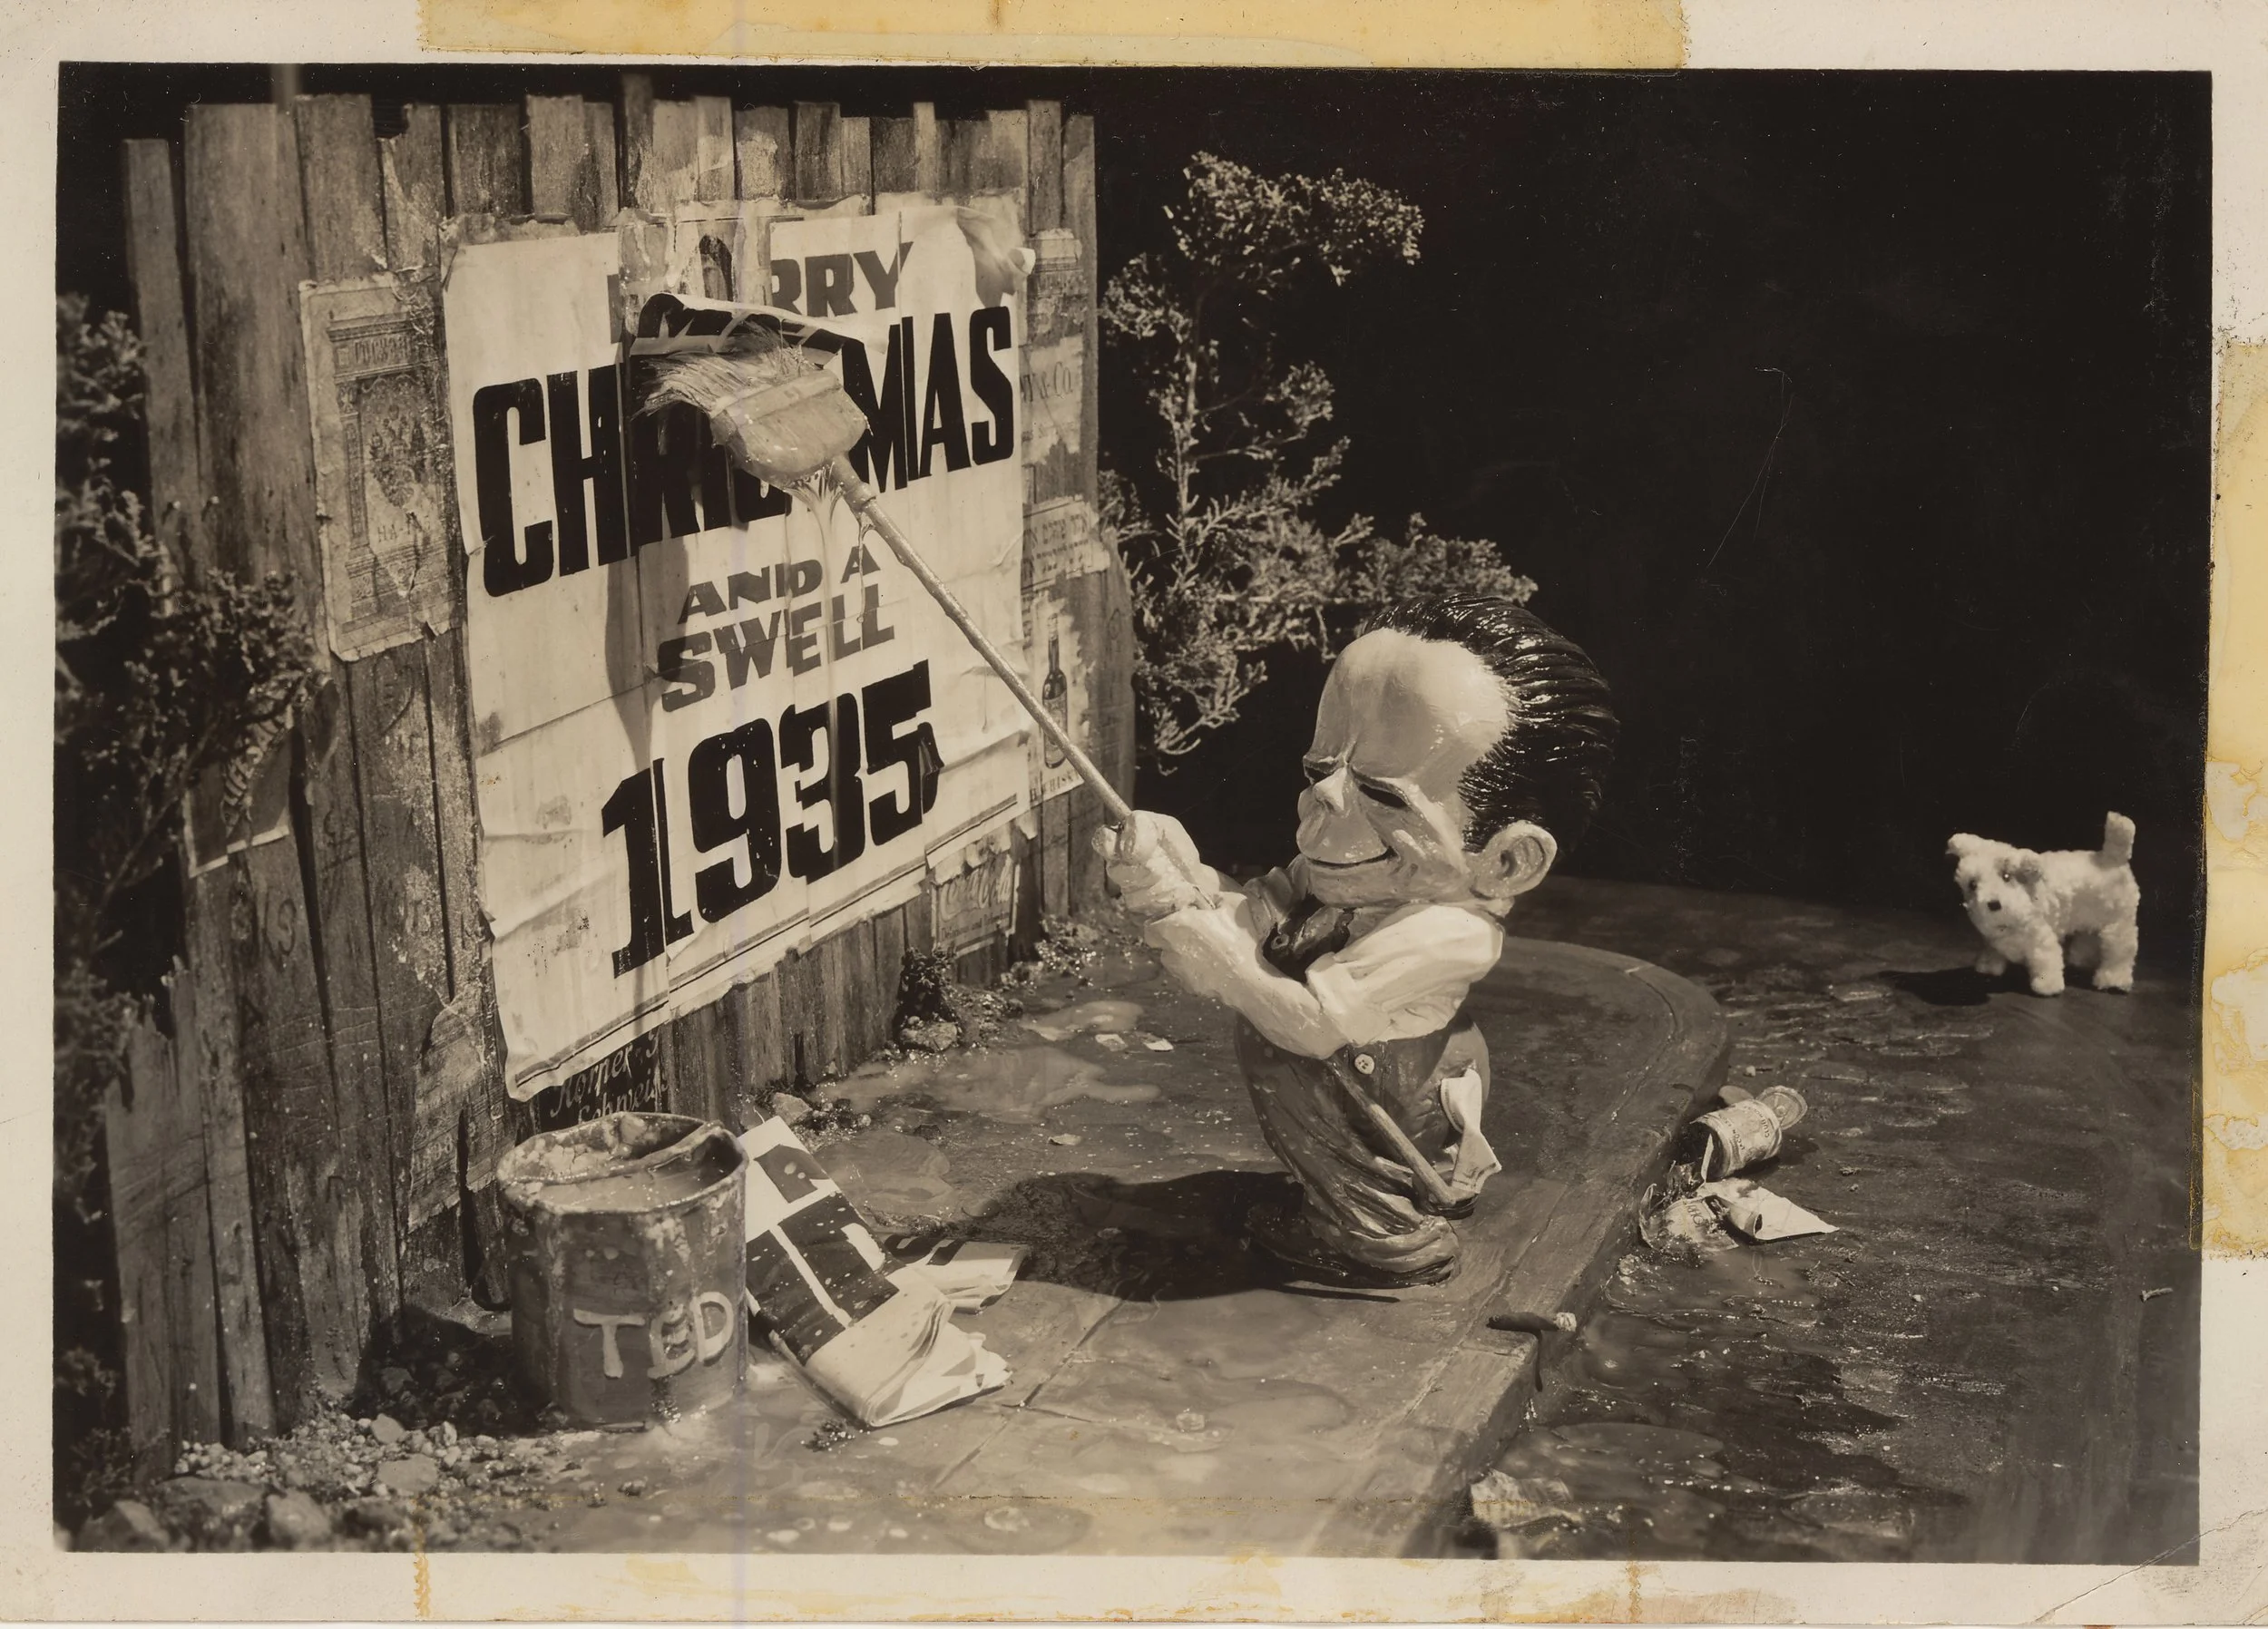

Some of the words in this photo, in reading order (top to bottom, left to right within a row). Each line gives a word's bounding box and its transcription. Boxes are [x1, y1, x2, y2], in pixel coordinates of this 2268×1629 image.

[472, 306, 1014, 598] CHRIMAS
[658, 583, 895, 713] SWELL
[678, 559, 823, 624] AND
[840, 544, 883, 585] A
[601, 659, 944, 980] 1935
[572, 1290, 735, 1379] TED
